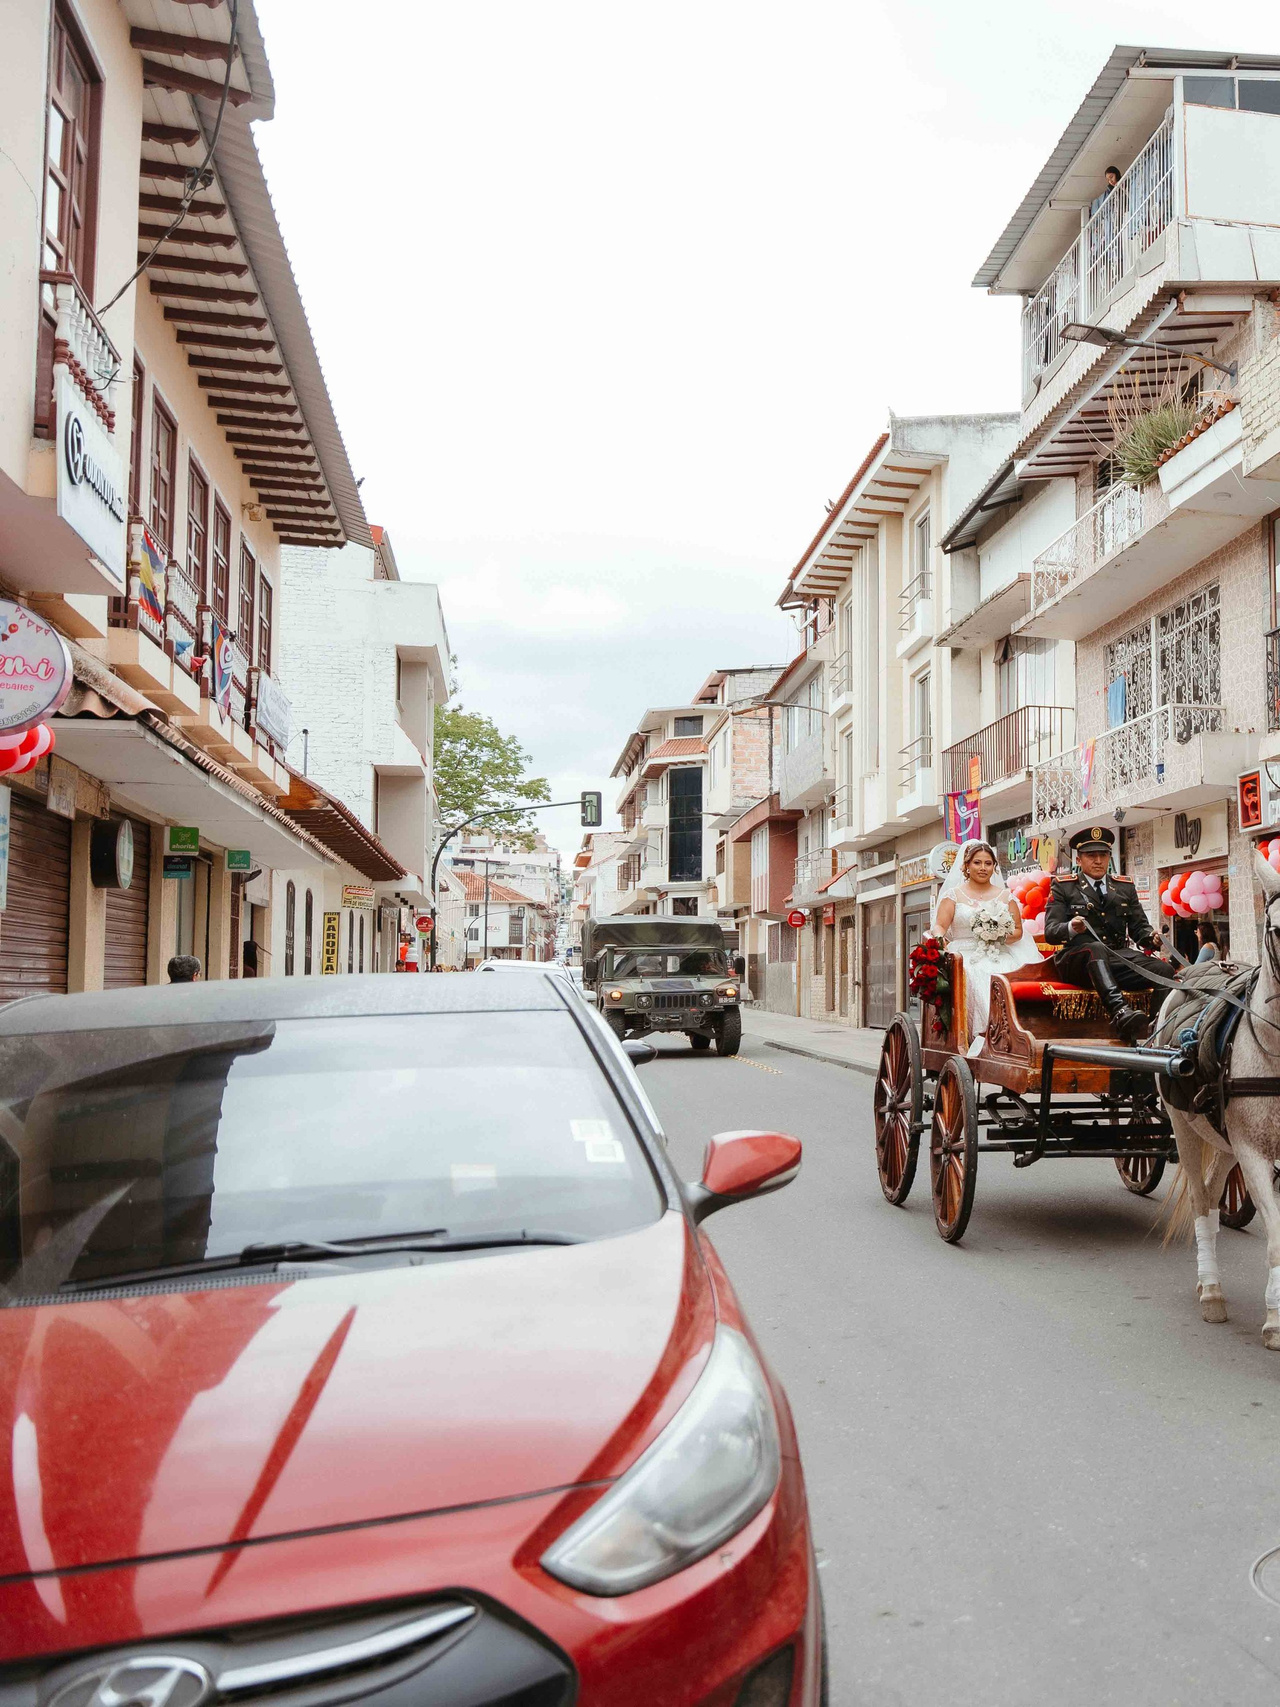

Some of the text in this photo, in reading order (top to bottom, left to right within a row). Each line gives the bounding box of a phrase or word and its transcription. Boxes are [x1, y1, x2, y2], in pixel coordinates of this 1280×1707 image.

[0, 654, 55, 681] emi
[0, 682, 35, 692] etalles
[325, 917, 337, 974] PARQUEA
